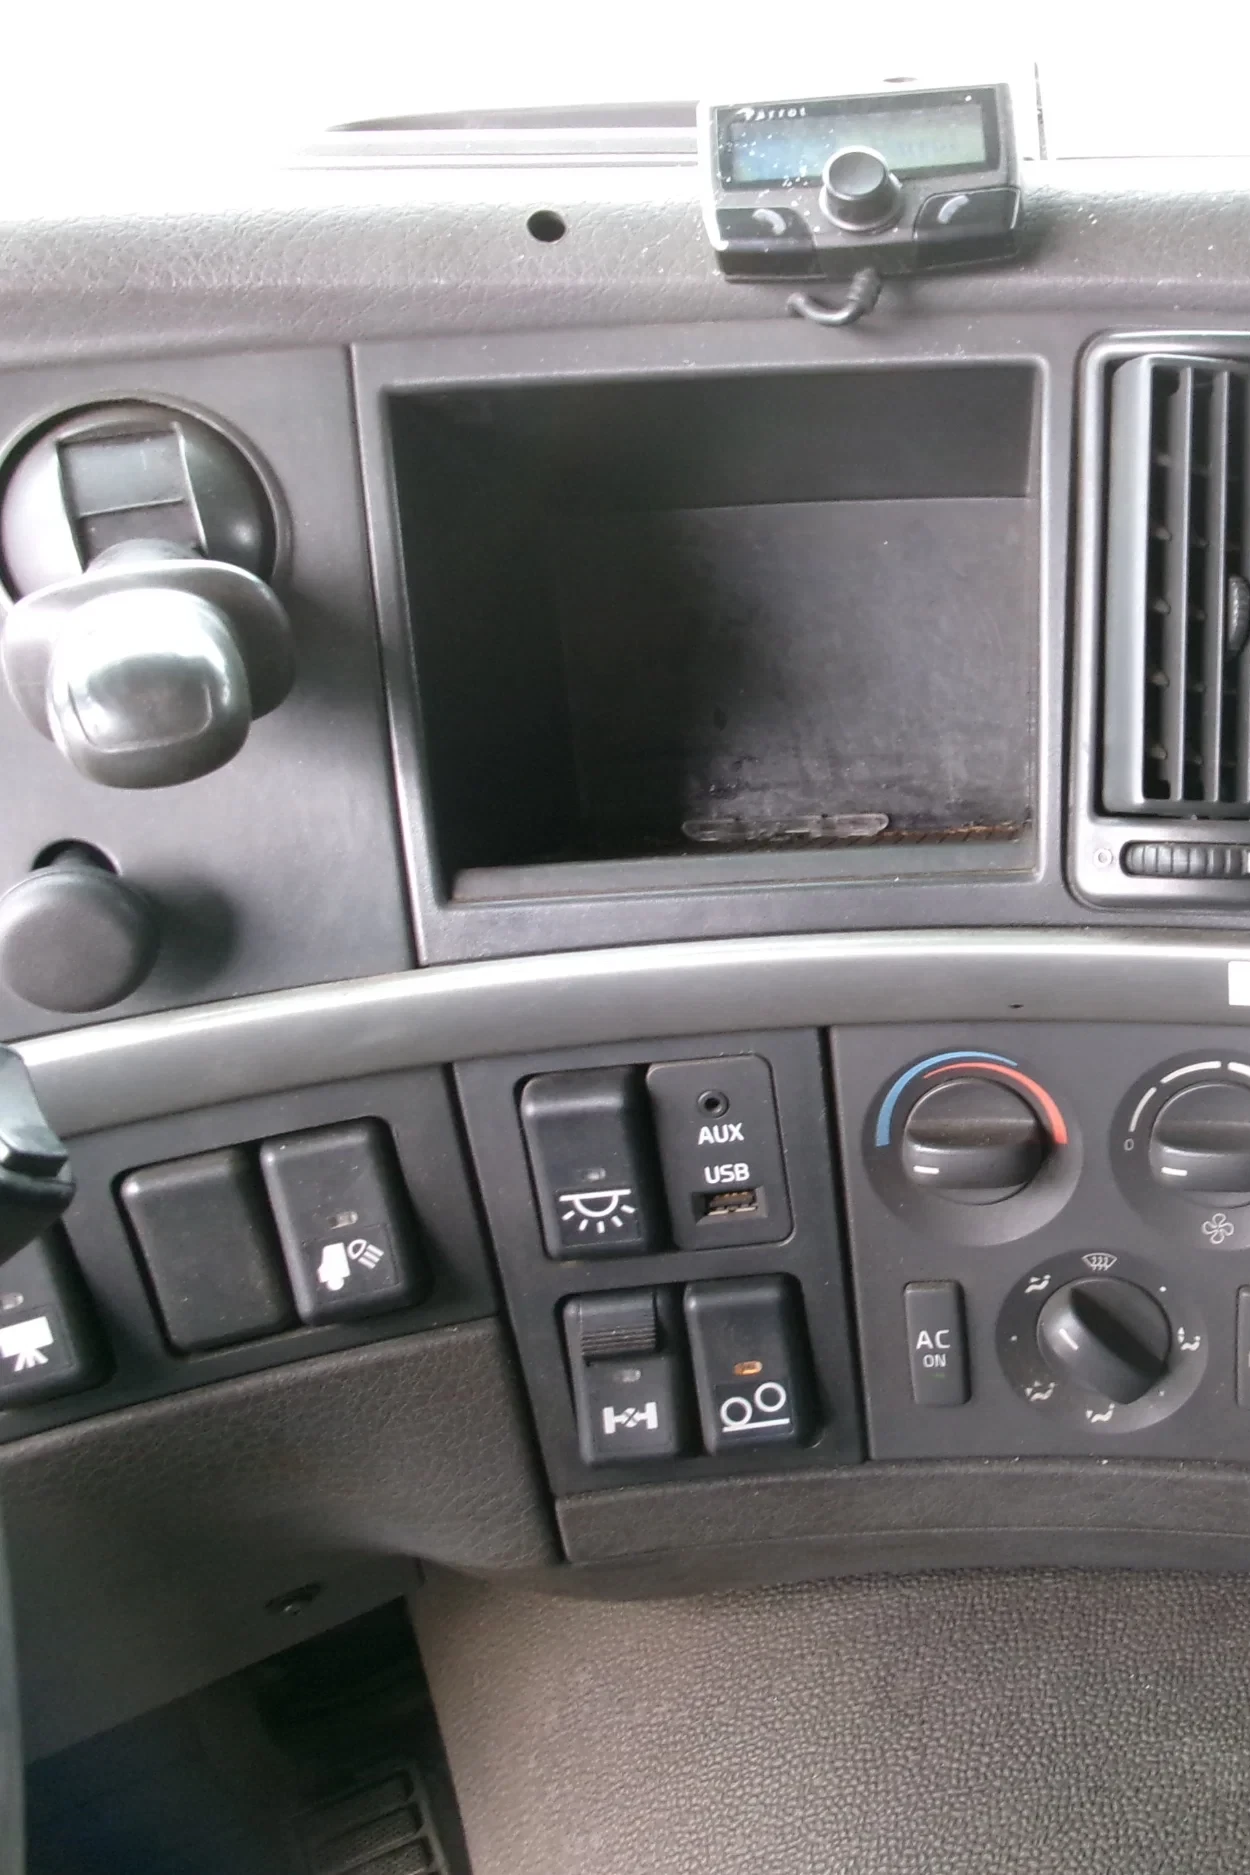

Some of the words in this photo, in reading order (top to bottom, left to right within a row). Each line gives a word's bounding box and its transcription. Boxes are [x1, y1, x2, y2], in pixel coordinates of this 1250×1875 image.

[698, 1122, 744, 1145] AUX
[704, 1162, 750, 1184] USB
[916, 1329, 951, 1350] AC
[922, 1352, 947, 1369] ON
